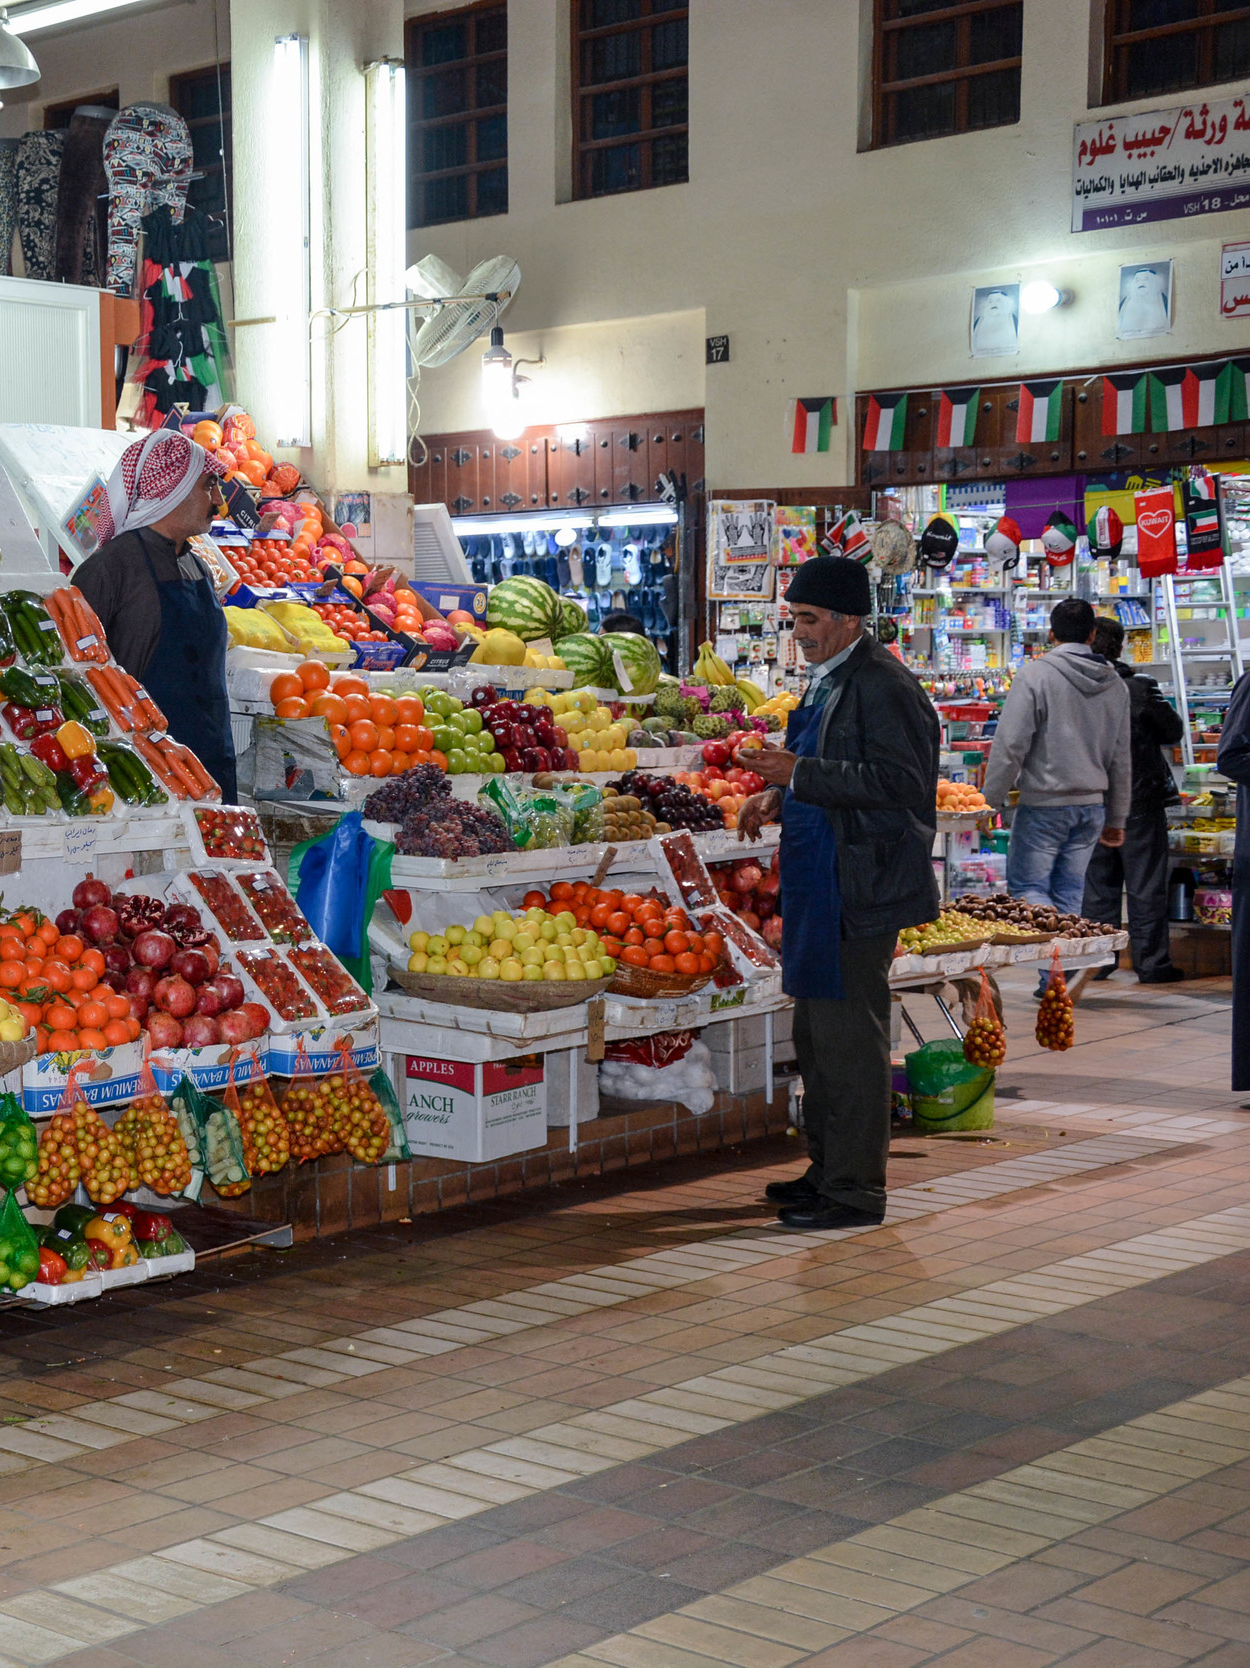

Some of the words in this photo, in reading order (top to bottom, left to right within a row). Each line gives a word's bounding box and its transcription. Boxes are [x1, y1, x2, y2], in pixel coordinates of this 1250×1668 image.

[1078, 123, 1117, 168] غلوم
[1075, 175, 1115, 199] والكماليات
[1119, 171, 1147, 195] الهدايا
[1183, 201, 1200, 214] VSH
[1202, 197, 1222, 211] 18
[1225, 260, 1239, 275] من
[710, 337, 727, 347] VSH
[711, 347, 724, 361] 17
[1141, 514, 1169, 527] KUWAIT
[410, 1059, 455, 1076] APPLES
[407, 1093, 455, 1114] ANCH
[490, 1092, 512, 1108] STARR
[512, 1086, 536, 1101] RANCH
[406, 1110, 451, 1125] growers
